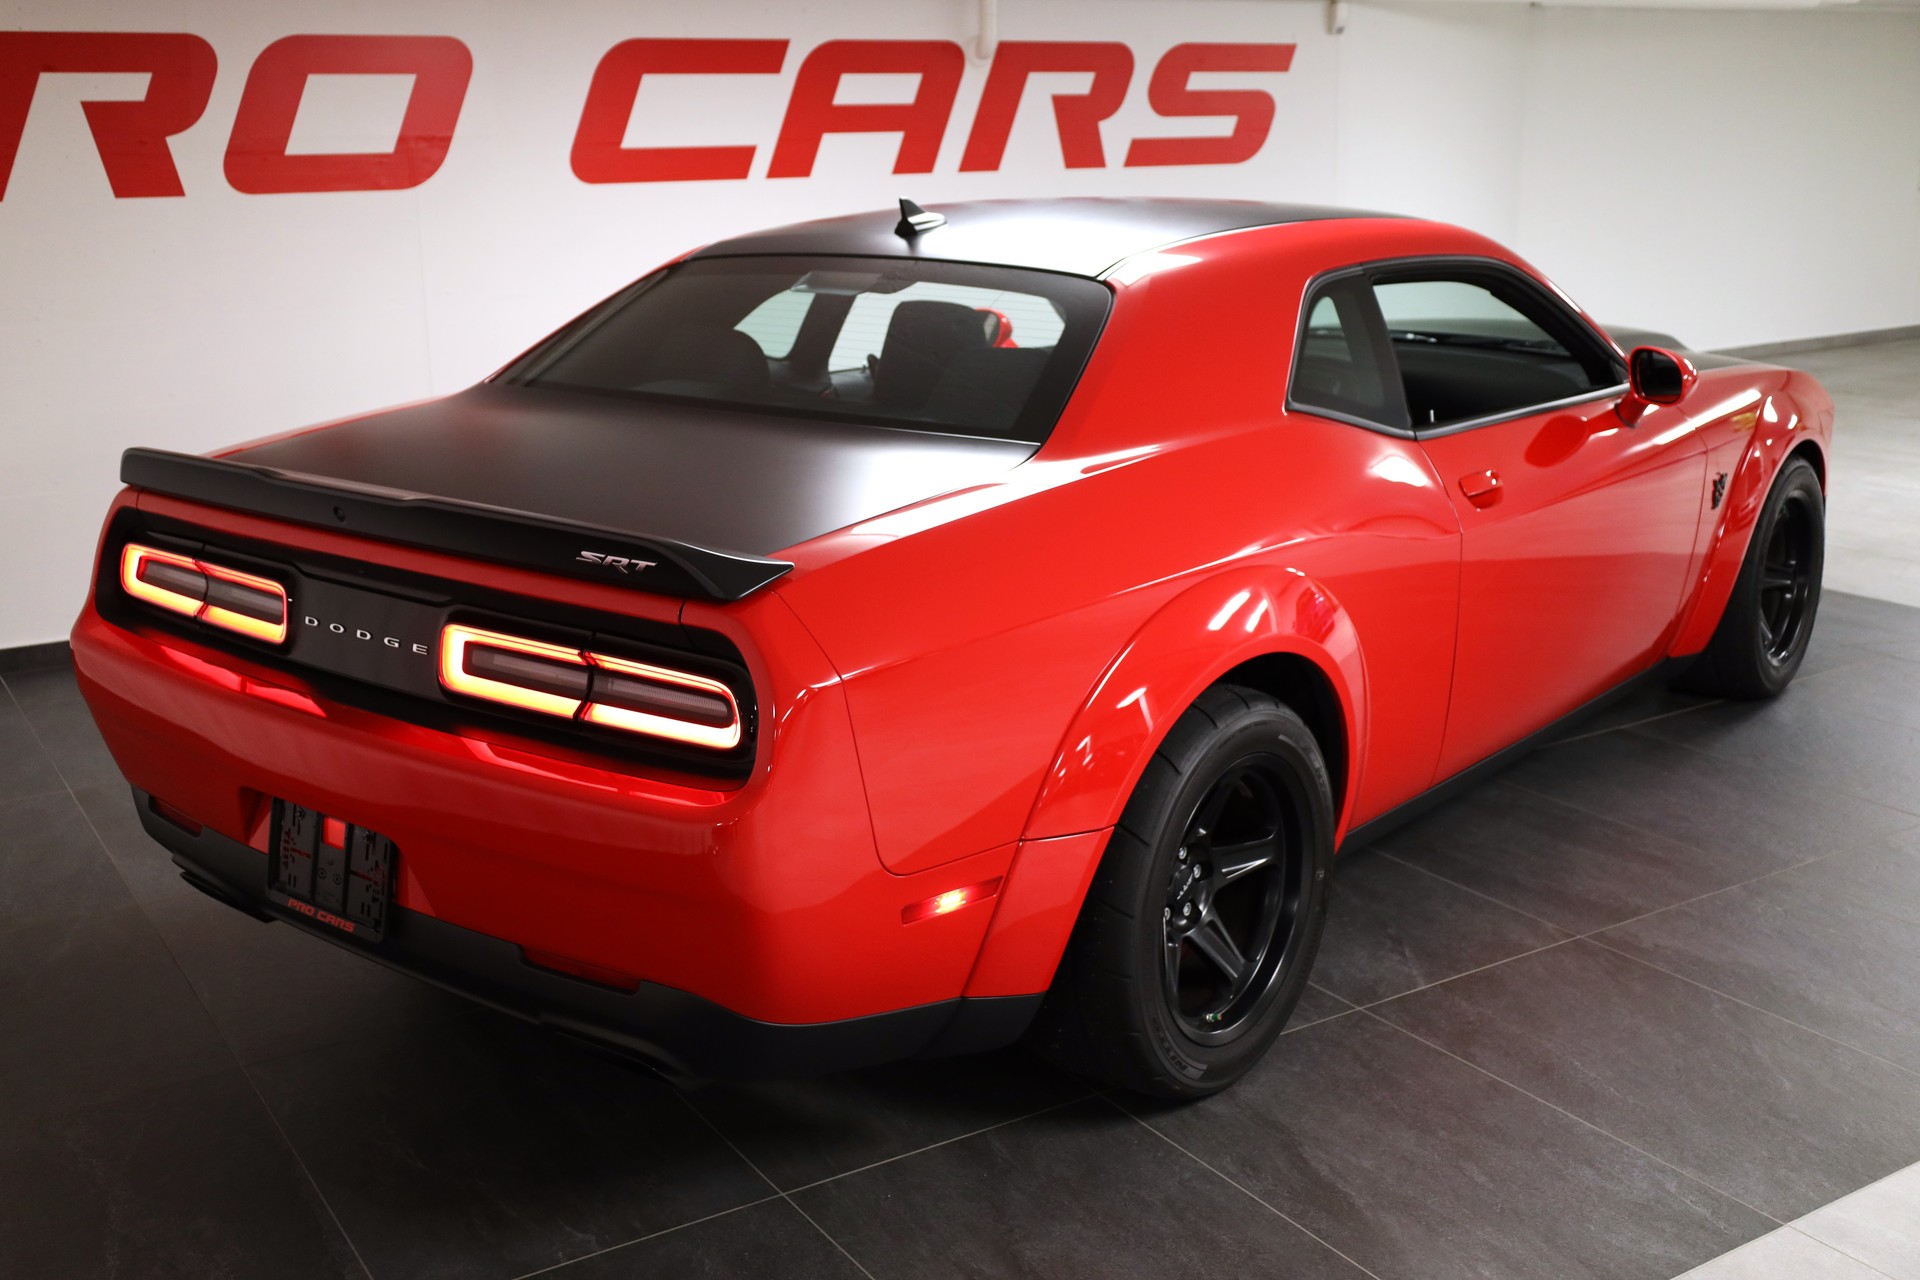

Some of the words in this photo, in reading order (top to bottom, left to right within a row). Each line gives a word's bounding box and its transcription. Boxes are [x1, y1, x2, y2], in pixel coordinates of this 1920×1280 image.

[570, 37, 1297, 185] CARS
[576, 550, 658, 574] SRT
[304, 615, 428, 655] DODGE
[287, 898, 315, 918] PRO
[316, 911, 356, 933] CARS
